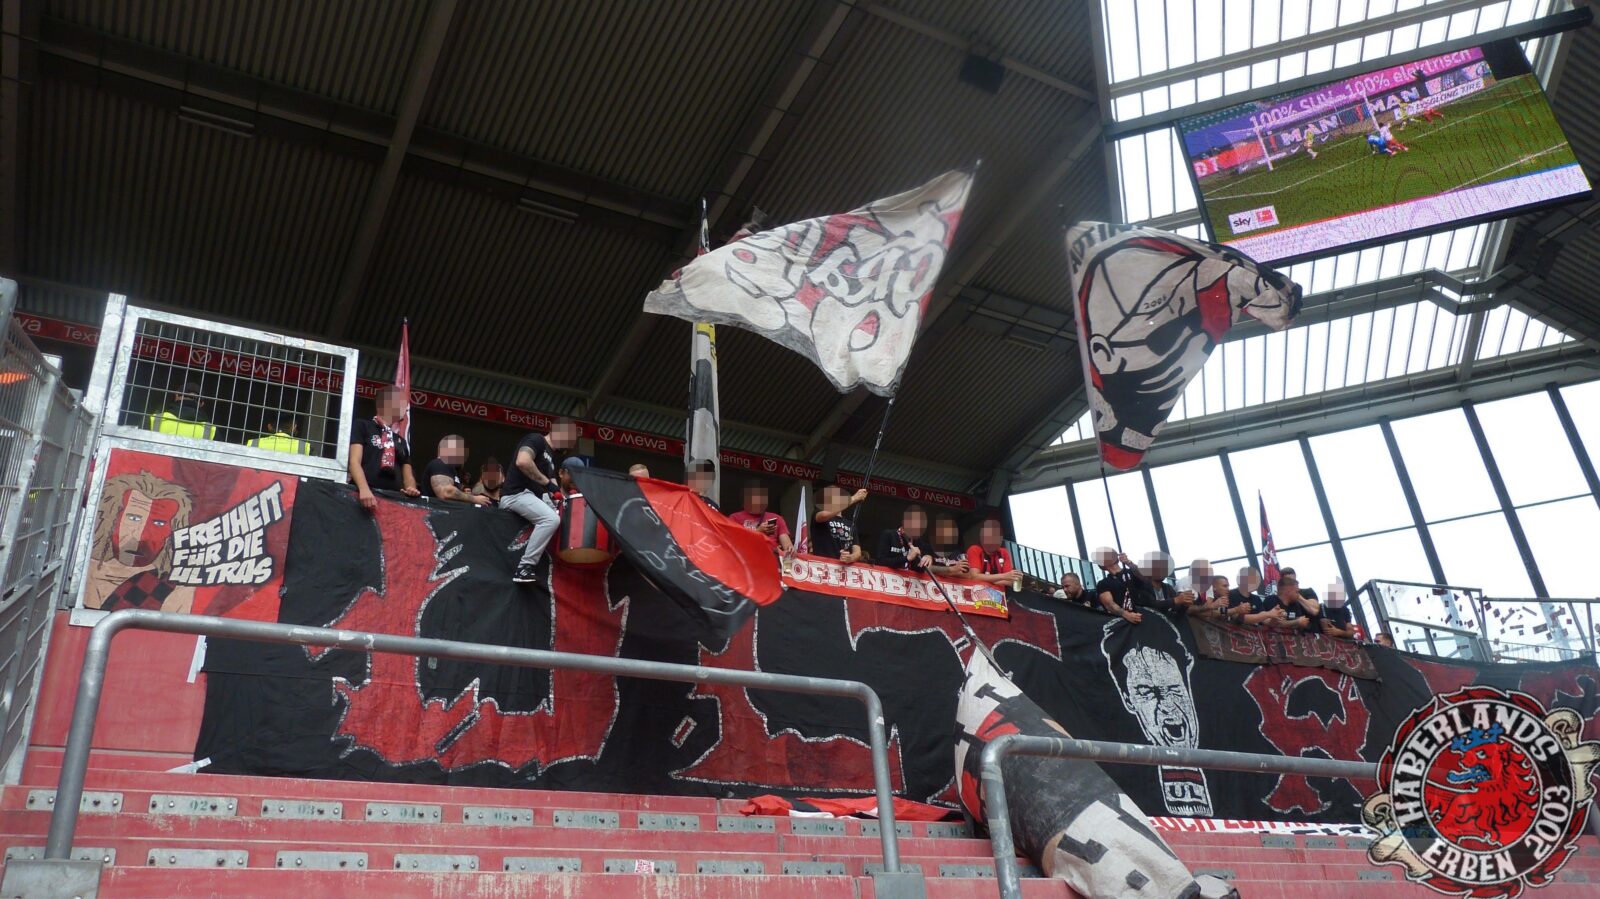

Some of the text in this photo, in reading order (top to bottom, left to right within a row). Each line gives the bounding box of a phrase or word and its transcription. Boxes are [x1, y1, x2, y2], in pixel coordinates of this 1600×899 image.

[1367, 86, 1420, 113] MAN
[1233, 217, 1251, 228] sky
[173, 482, 282, 550] FREIHEIT
[172, 528, 265, 568] FÜR DIE
[168, 556, 274, 586] ULTRAS
[790, 559, 966, 605] OFFENBACH
